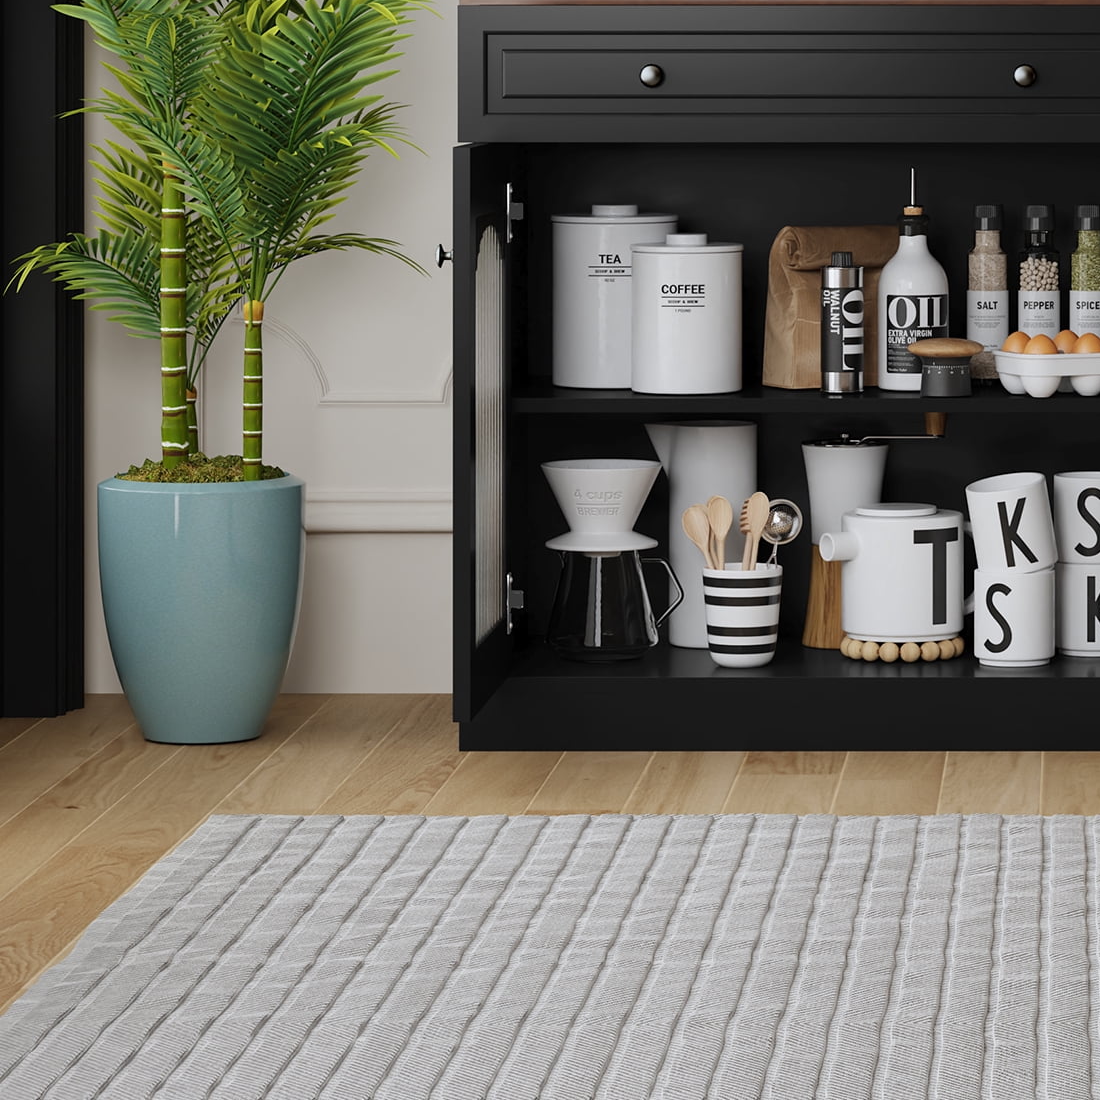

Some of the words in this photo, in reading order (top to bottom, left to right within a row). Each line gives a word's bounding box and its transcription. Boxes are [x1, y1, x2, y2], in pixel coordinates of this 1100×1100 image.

[598, 255, 622, 264] TEA
[661, 285, 705, 294] COFFEE
[823, 290, 831, 307] OIL
[830, 290, 841, 334] WALNUT
[888, 296, 948, 328] OIL
[976, 301, 998, 310] SALT
[1023, 301, 1055, 310] PEPPER
[842, 290, 864, 371] OIL
[888, 329, 908, 337] EXTRA
[909, 329, 933, 337] VIRGIN
[997, 497, 1039, 568] K
[913, 527, 959, 625] T
[984, 583, 1013, 653] S
